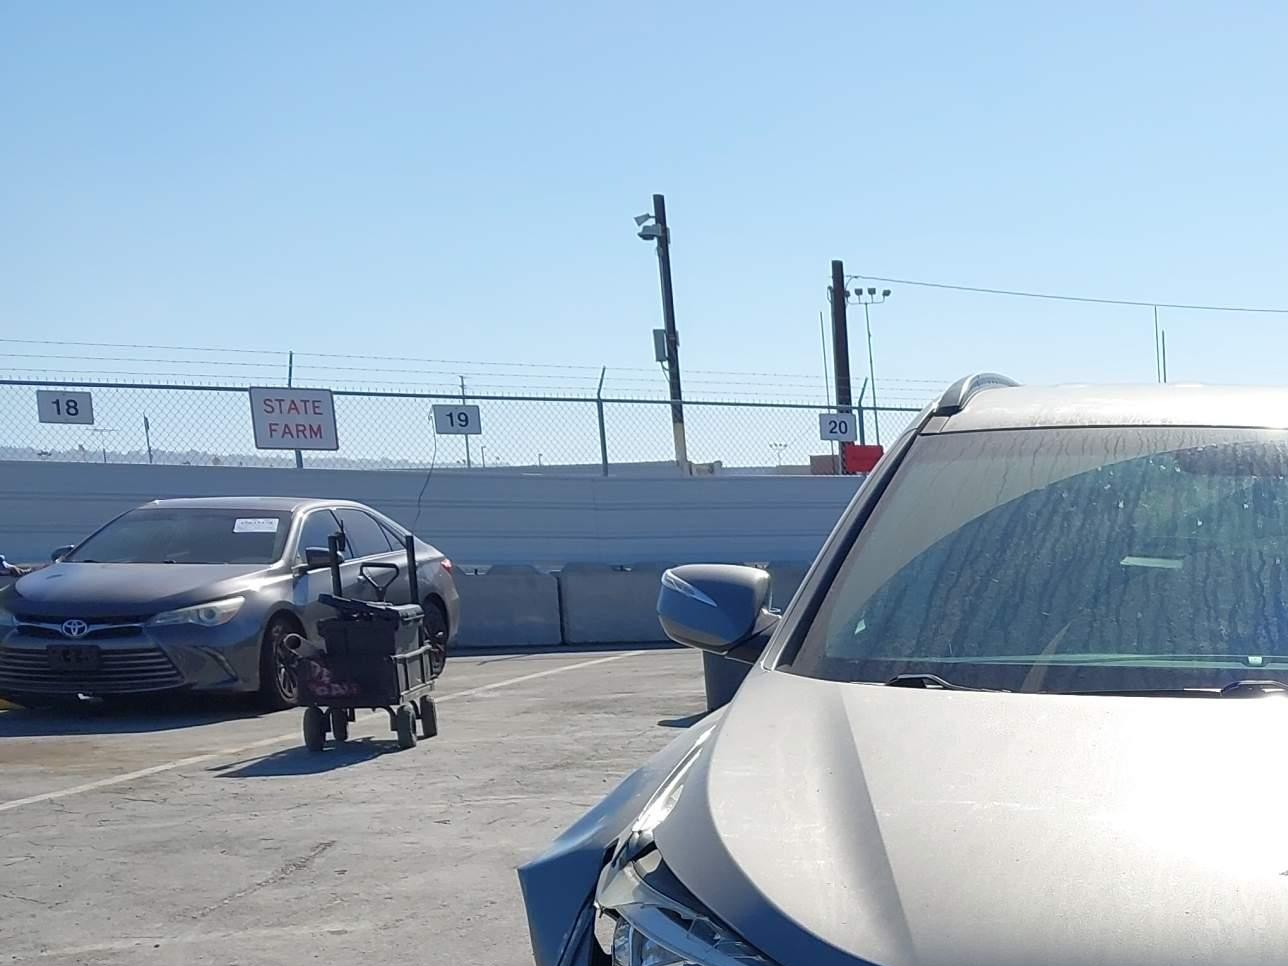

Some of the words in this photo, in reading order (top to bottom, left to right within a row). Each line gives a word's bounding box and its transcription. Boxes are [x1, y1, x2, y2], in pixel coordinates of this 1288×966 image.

[51, 398, 79, 417] 18
[263, 398, 324, 417] STATE
[445, 411, 469, 428] 19
[828, 420, 848, 435] 20
[268, 422, 323, 440] FARM
